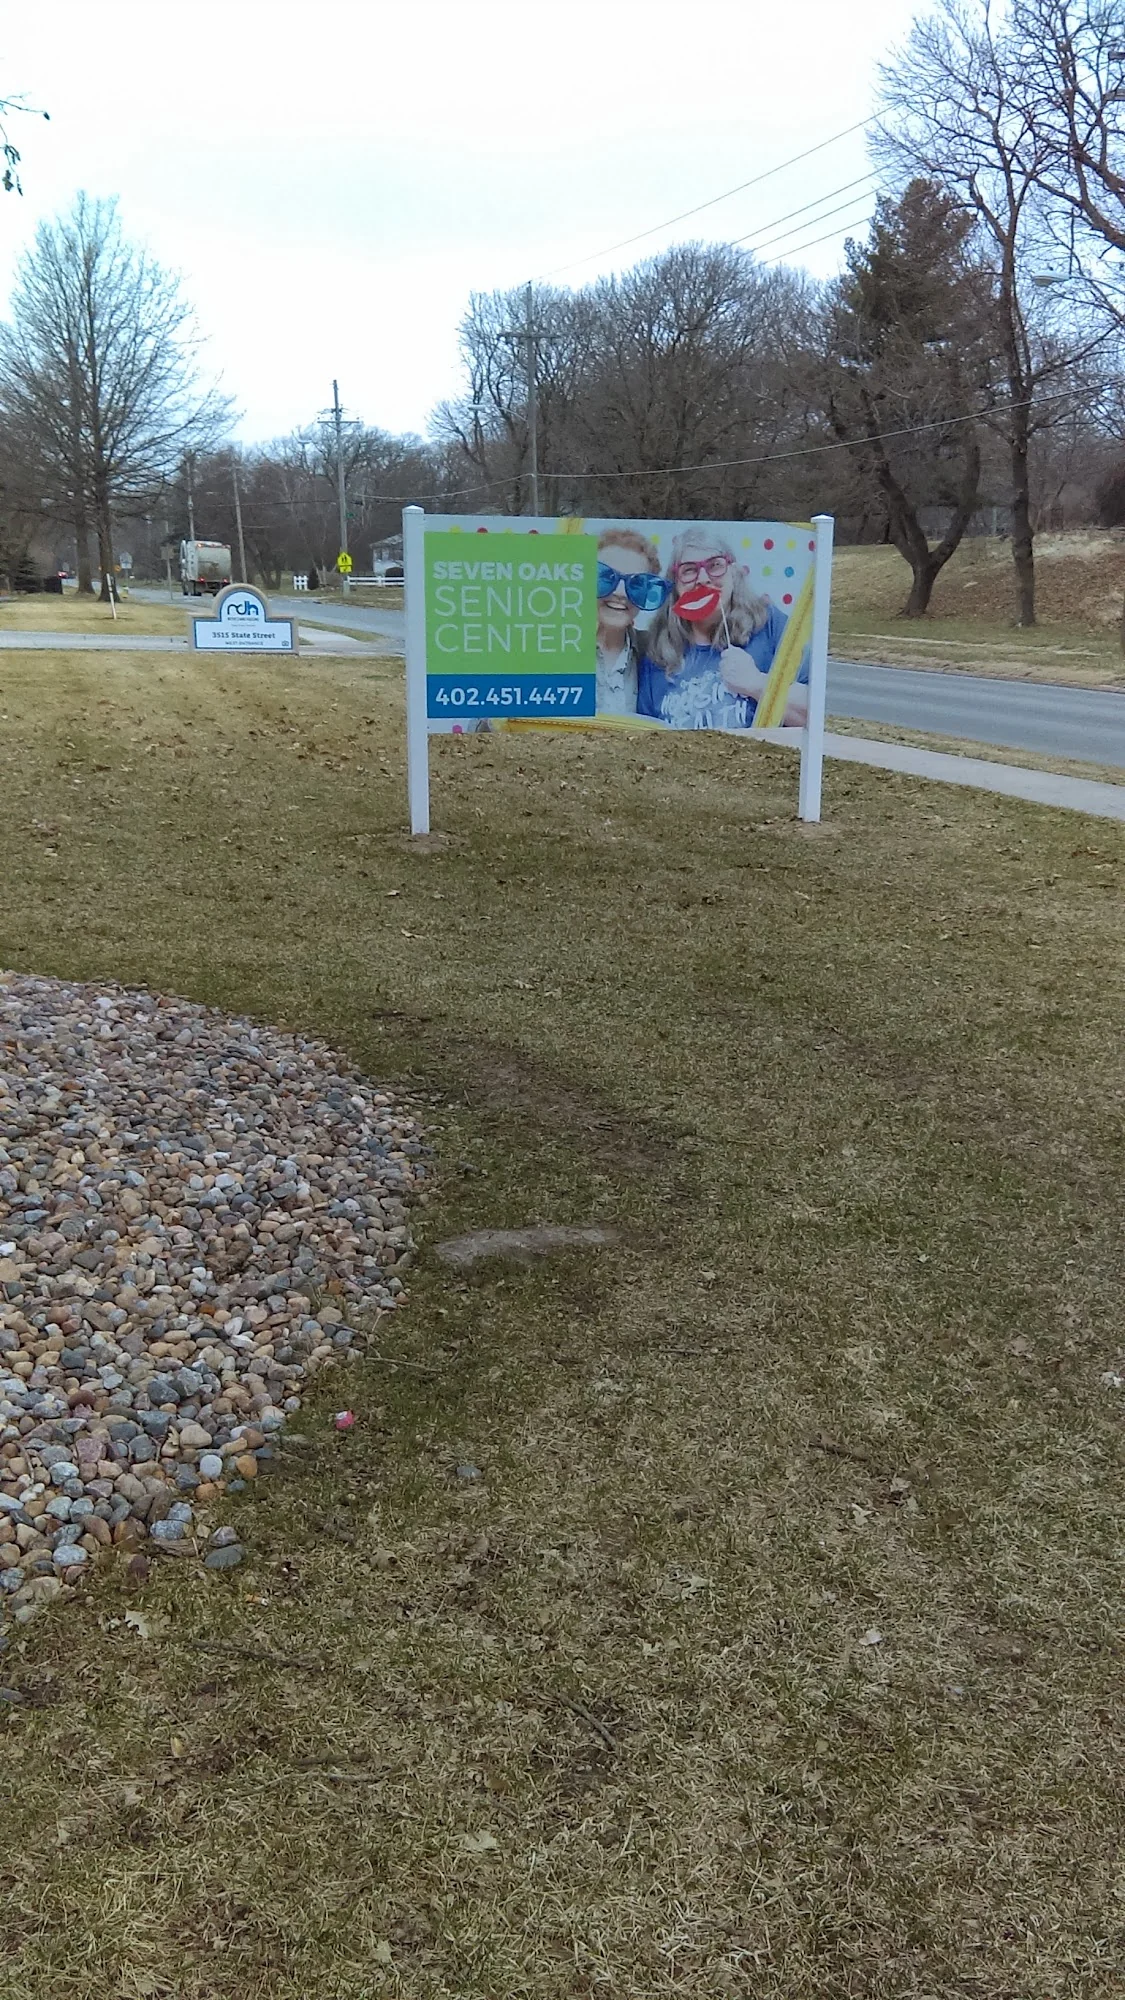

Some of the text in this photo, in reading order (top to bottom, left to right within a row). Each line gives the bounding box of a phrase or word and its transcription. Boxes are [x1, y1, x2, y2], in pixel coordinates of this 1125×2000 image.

[433, 561, 584, 581] SEVEN OAKS
[434, 585, 584, 618] SENIOR
[434, 623, 583, 653] CENTER
[435, 687, 584, 706] 402.451.4477
